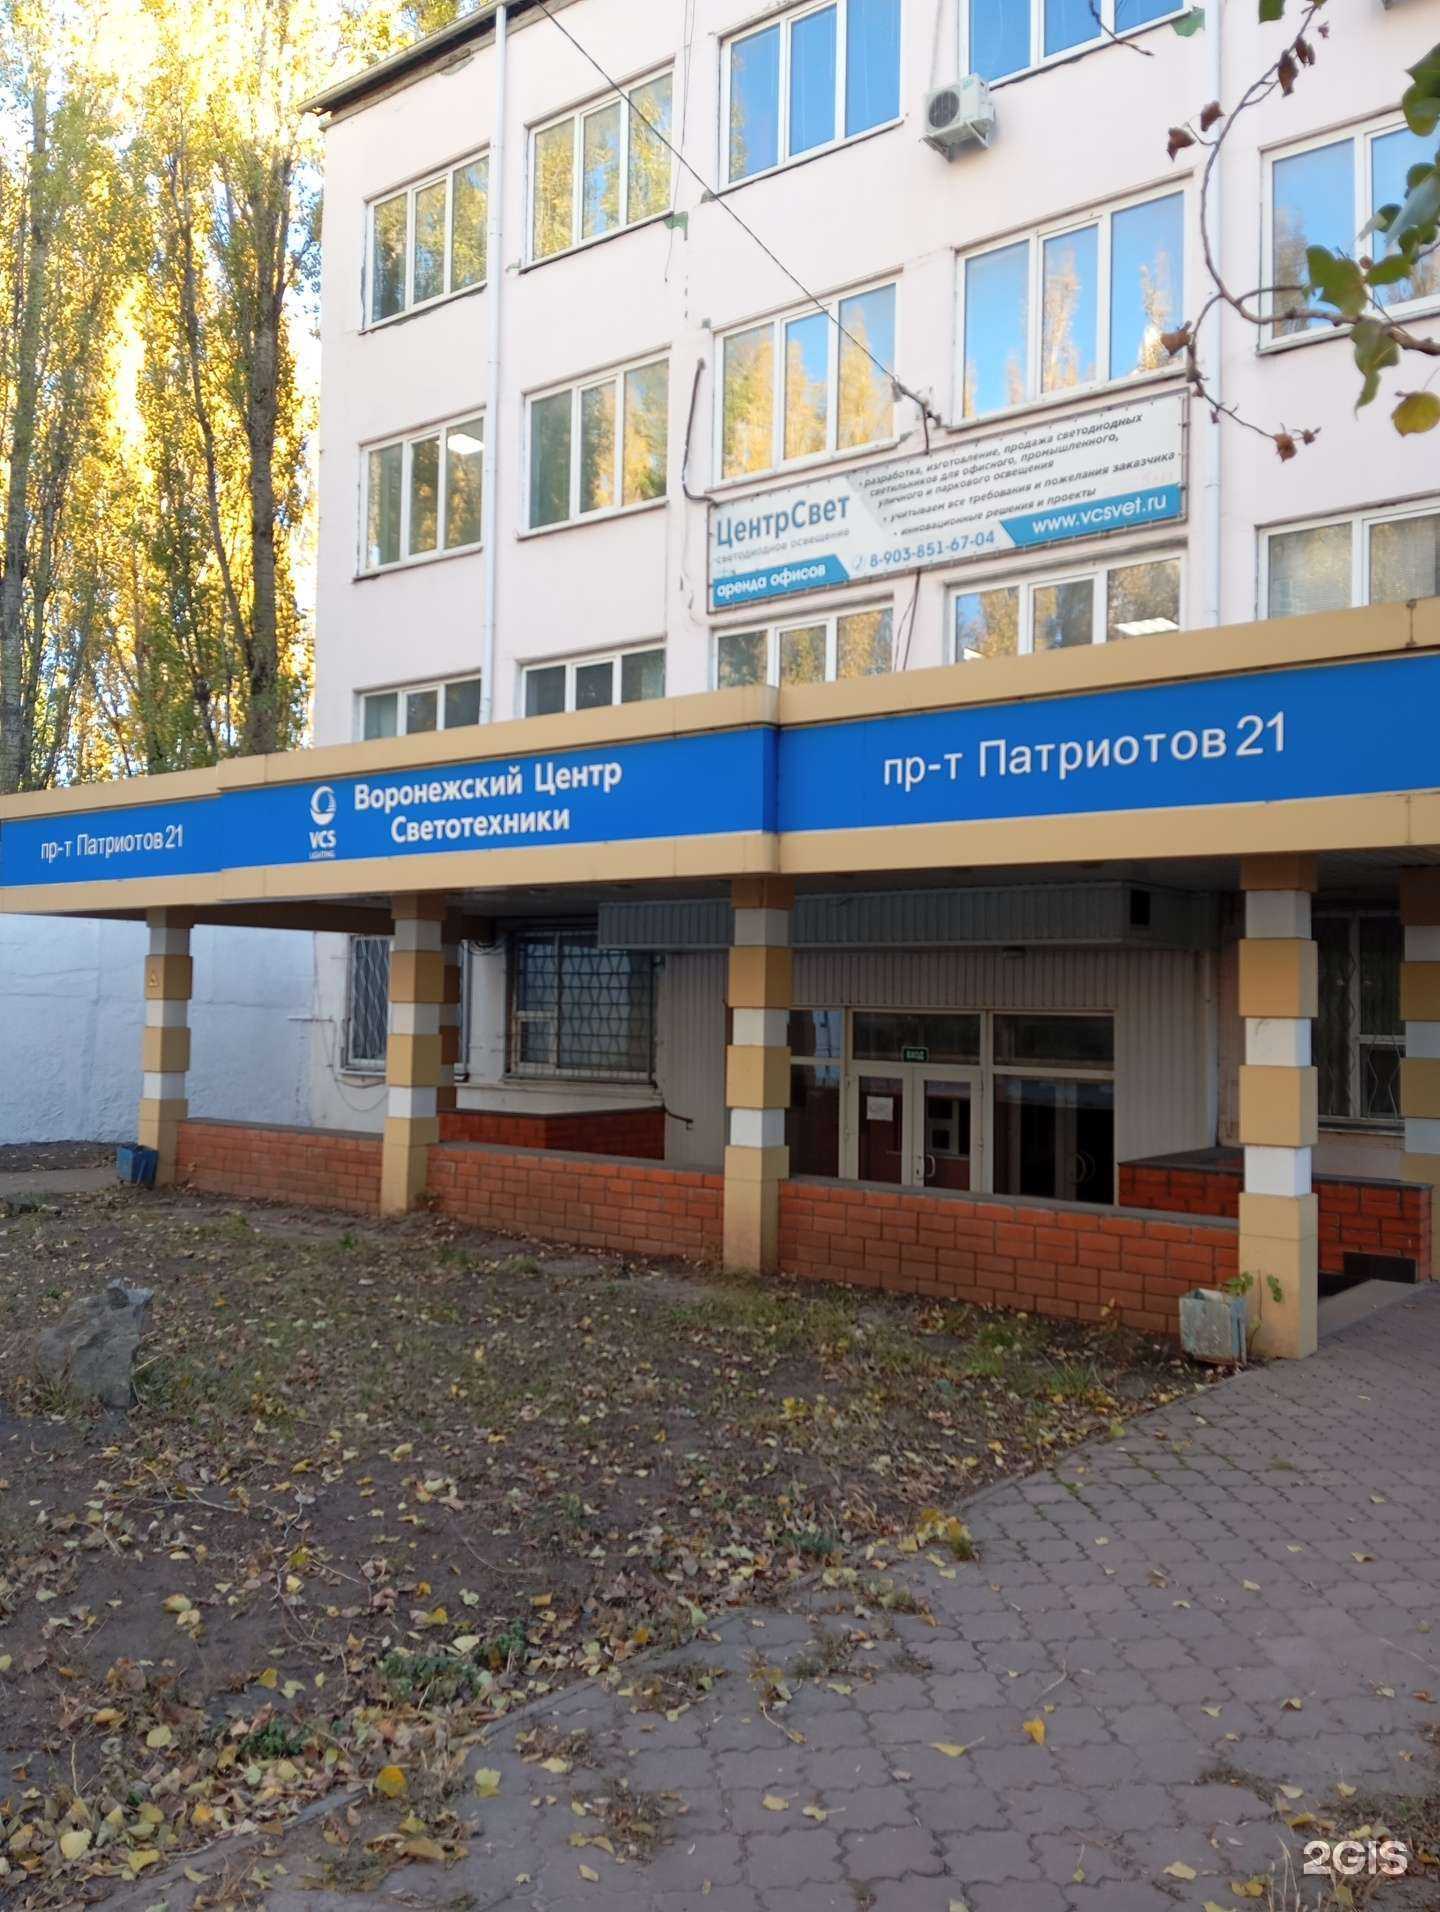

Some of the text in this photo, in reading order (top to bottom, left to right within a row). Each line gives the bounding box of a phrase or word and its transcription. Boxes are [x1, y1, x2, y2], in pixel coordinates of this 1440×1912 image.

[1004, 435, 1053, 455] продажа
[1057, 413, 1143, 441] светодиодных
[870, 432, 1119, 497] светильников для офисного, промышленного,
[878, 489, 923, 509] уличного
[935, 473, 990, 494] паркового
[993, 459, 1054, 481] освещения
[890, 502, 945, 523] учитываем
[947, 497, 965, 509] все
[968, 484, 1031, 506] требования
[1043, 466, 1109, 488] пожелания
[1112, 451, 1176, 472] заказчика
[717, 495, 850, 549] ЦентрСвет
[900, 512, 984, 536] инновационные
[985, 499, 1034, 519] решения
[1046, 488, 1096, 505] проекты
[1031, 494, 1167, 534] www.vcsvet.ru
[869, 530, 996, 567] 8-903-851-67-04
[716, 563, 826, 600] аренда офисов
[884, 711, 1285, 791] пр-т Патриотов 21
[354, 761, 622, 814] Воронежский Центр
[41, 824, 183, 864] пр-т Патриотов 21
[309, 829, 337, 849] VCS
[391, 808, 570, 843] Светотехники
